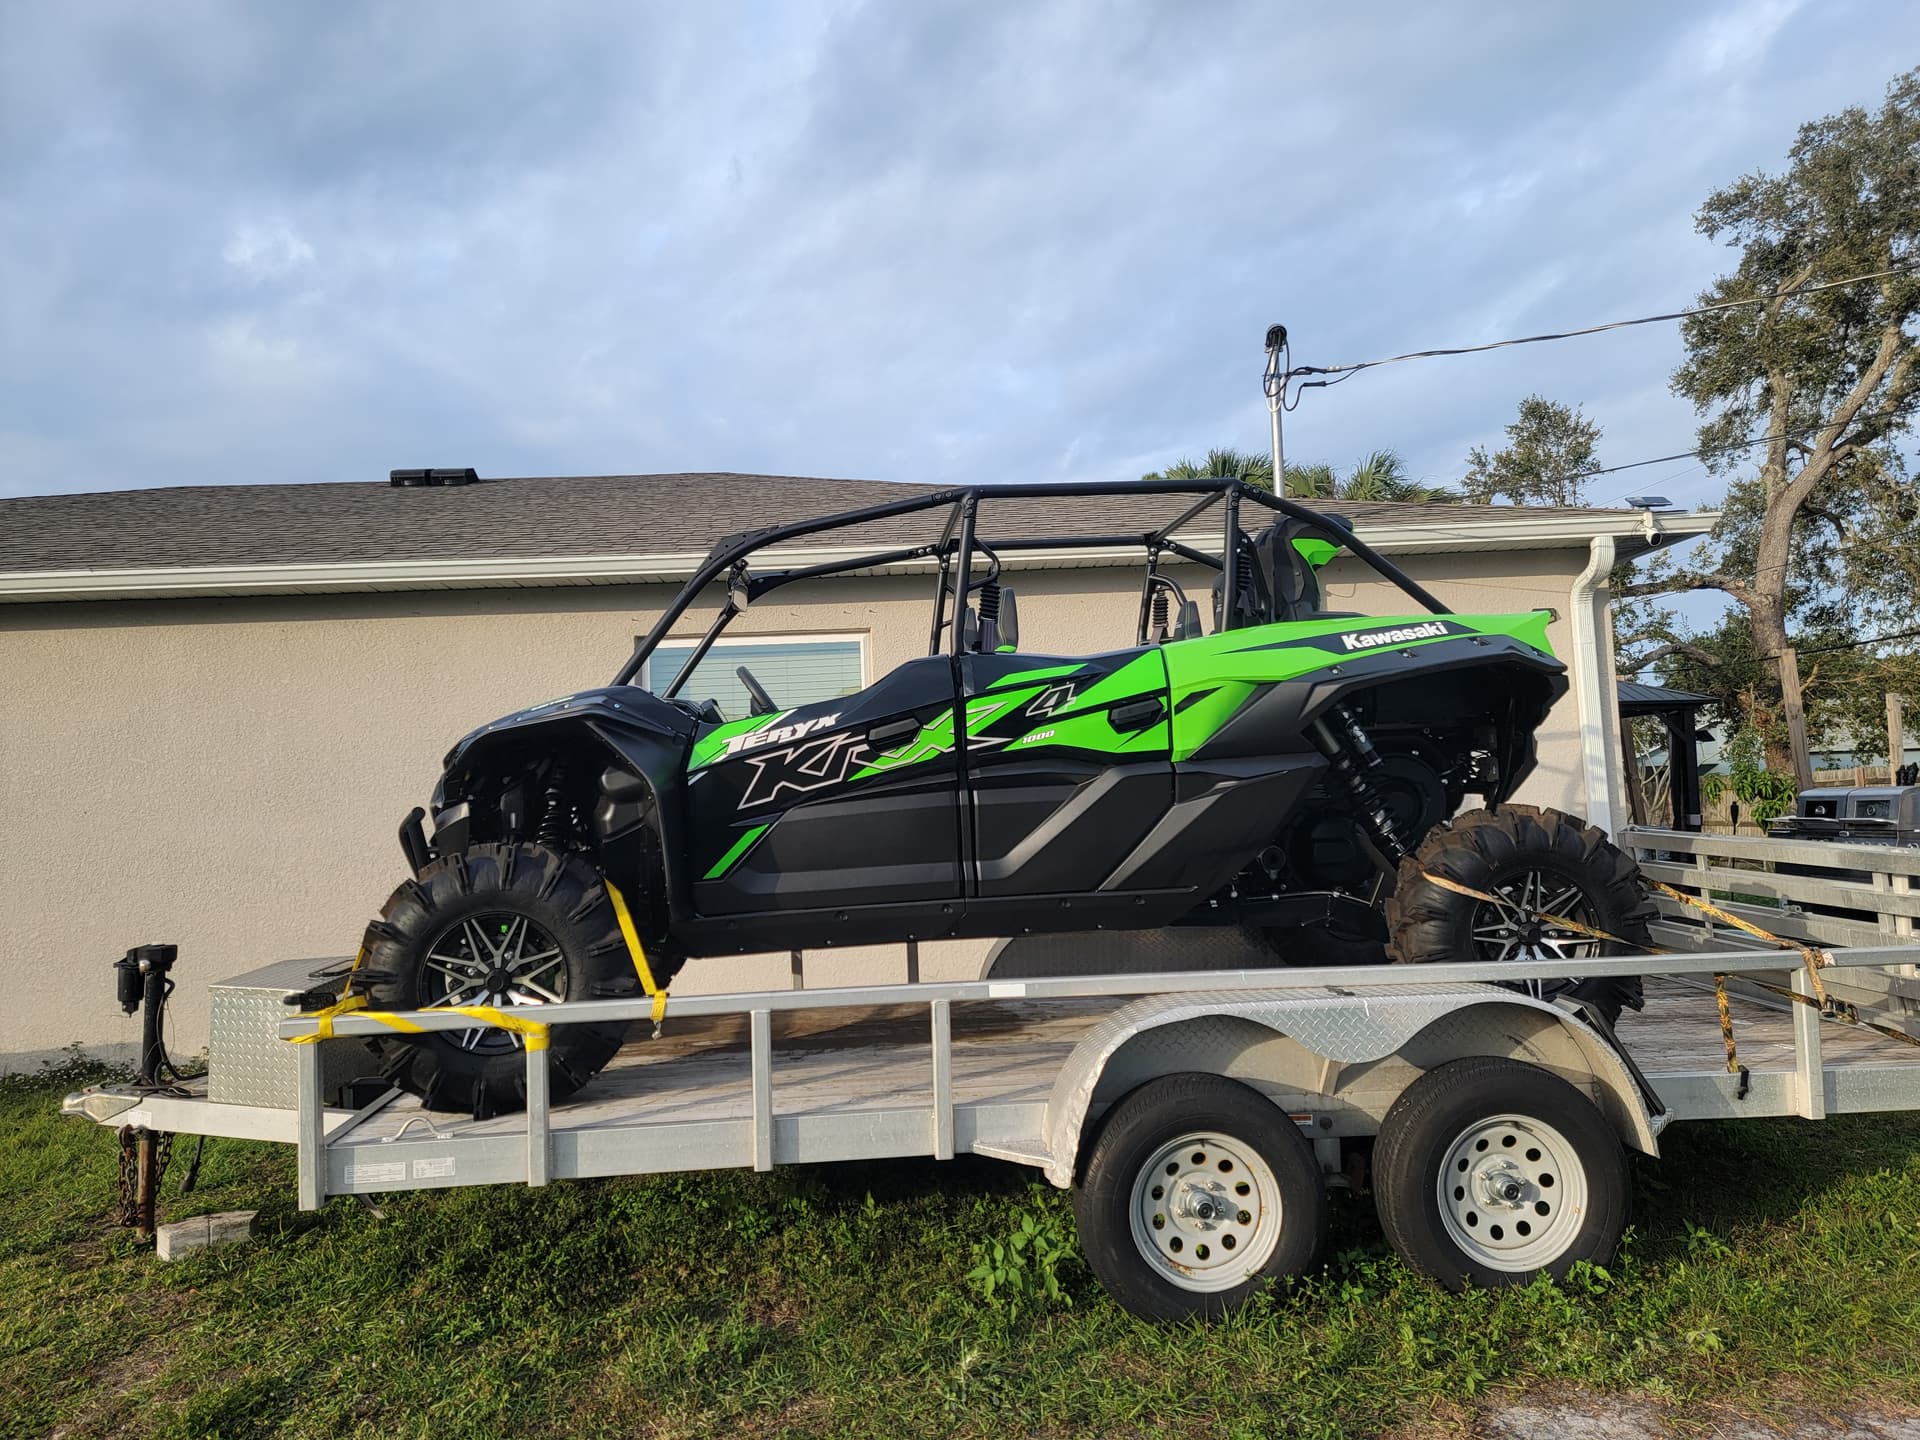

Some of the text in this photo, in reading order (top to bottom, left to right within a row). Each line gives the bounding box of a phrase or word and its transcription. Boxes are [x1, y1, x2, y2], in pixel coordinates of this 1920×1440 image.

[1341, 622, 1448, 650] Kawasaki
[1026, 683, 1077, 717] 4
[721, 712, 842, 754] TERYX
[1022, 730, 1055, 744] 1000
